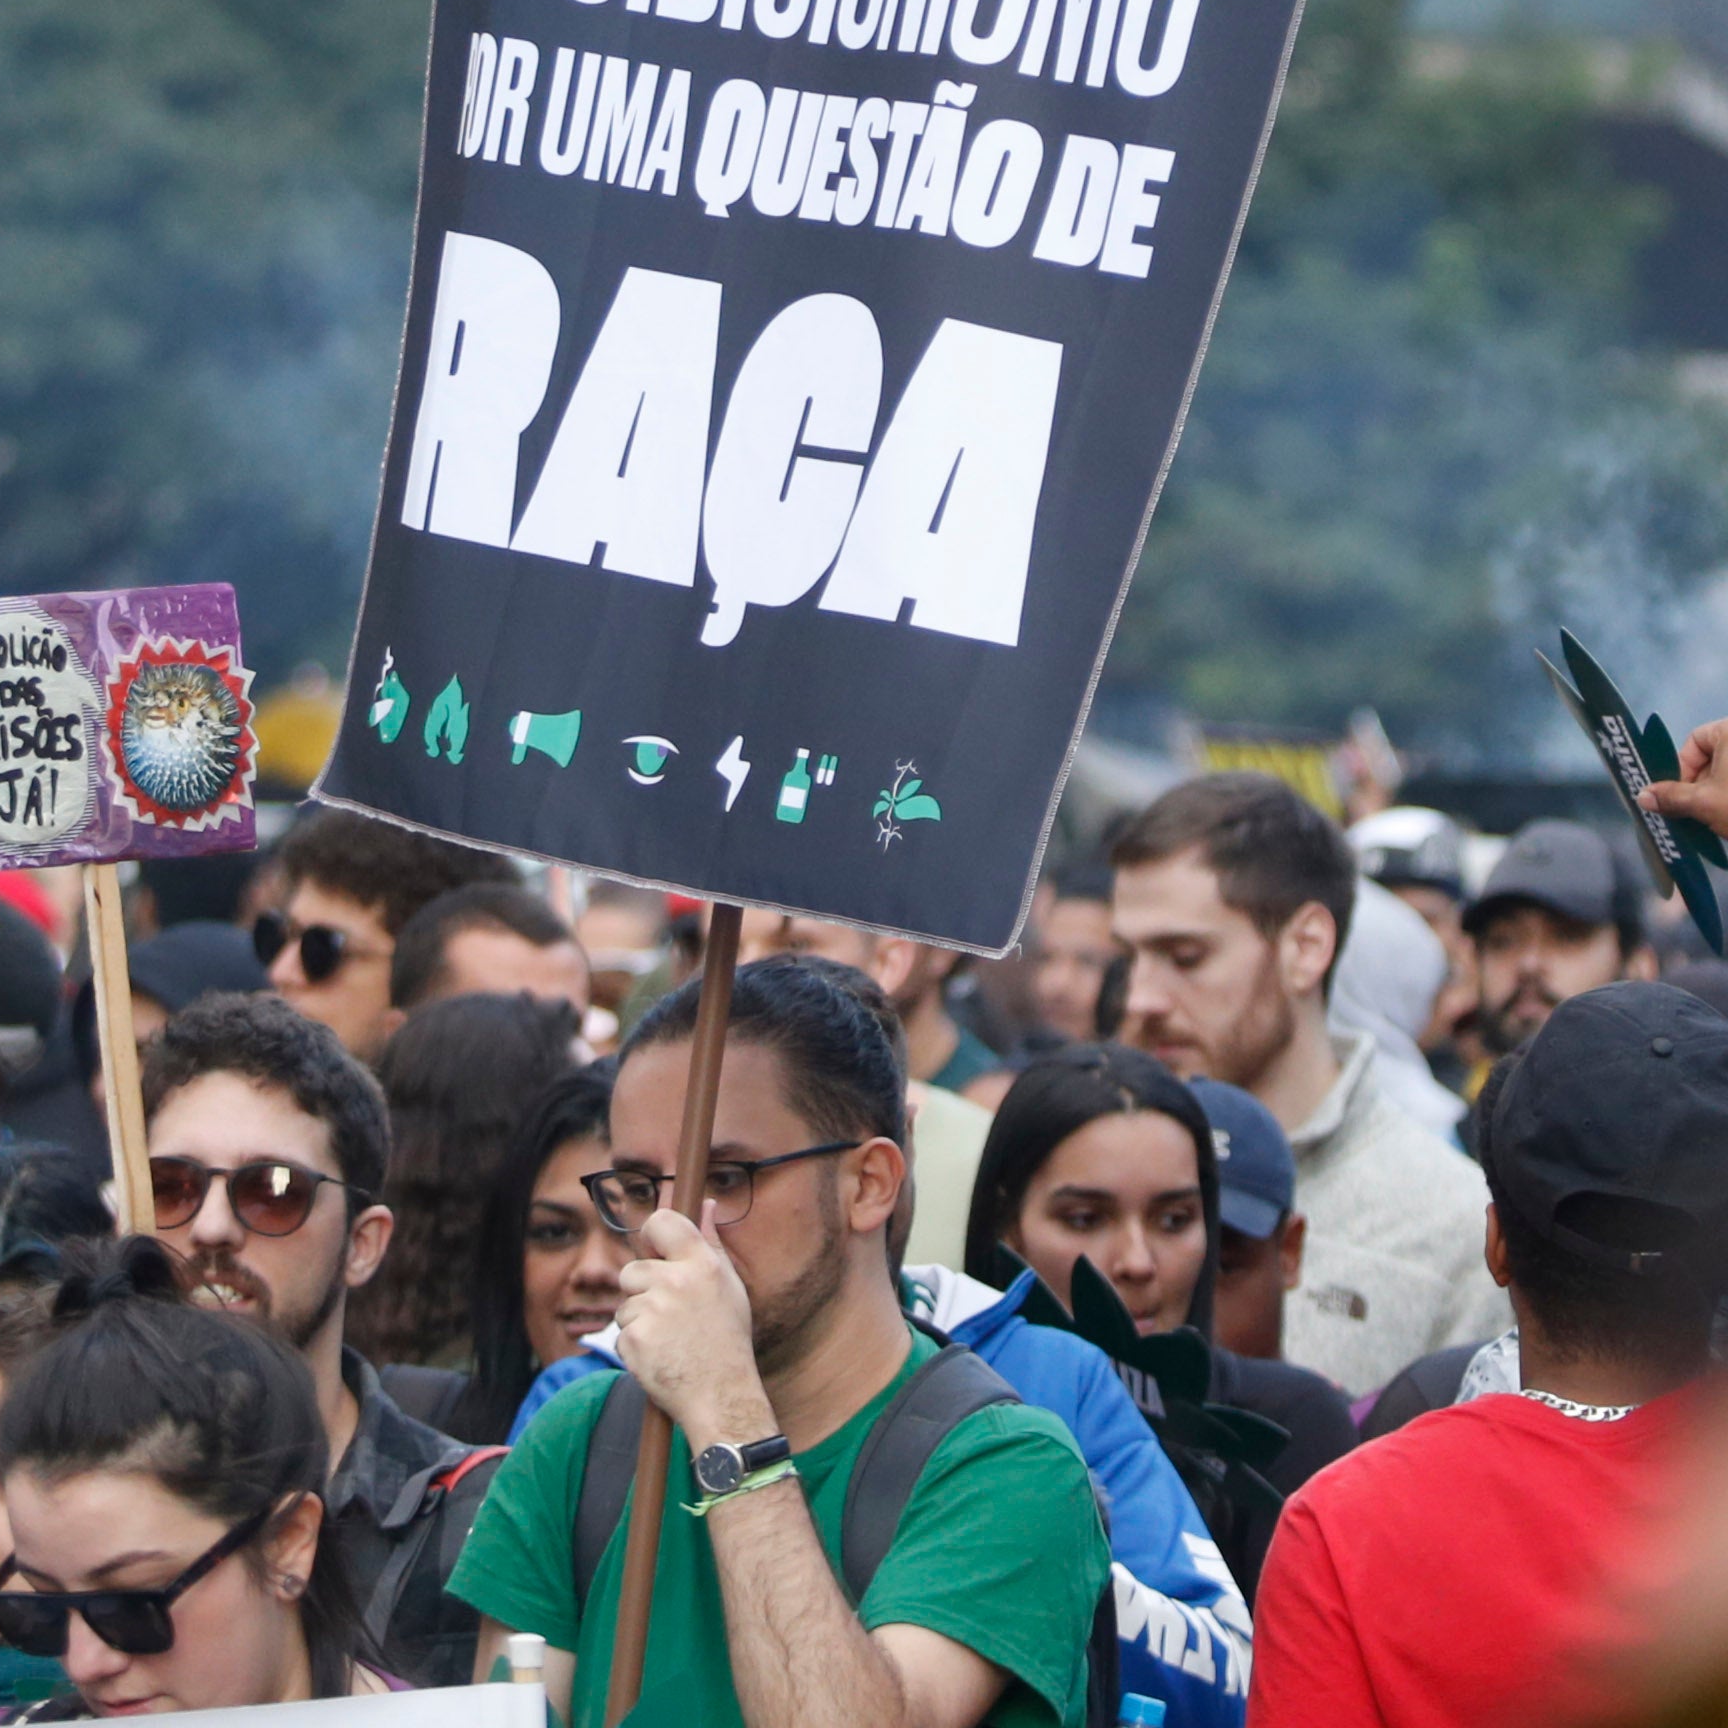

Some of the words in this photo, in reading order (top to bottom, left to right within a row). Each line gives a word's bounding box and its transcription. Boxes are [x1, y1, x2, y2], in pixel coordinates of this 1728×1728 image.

[540, 47, 692, 196] UMA
[694, 78, 1044, 248] QUESTÃO
[1032, 134, 1176, 279] DE
[401, 229, 1064, 647] RAÇA
